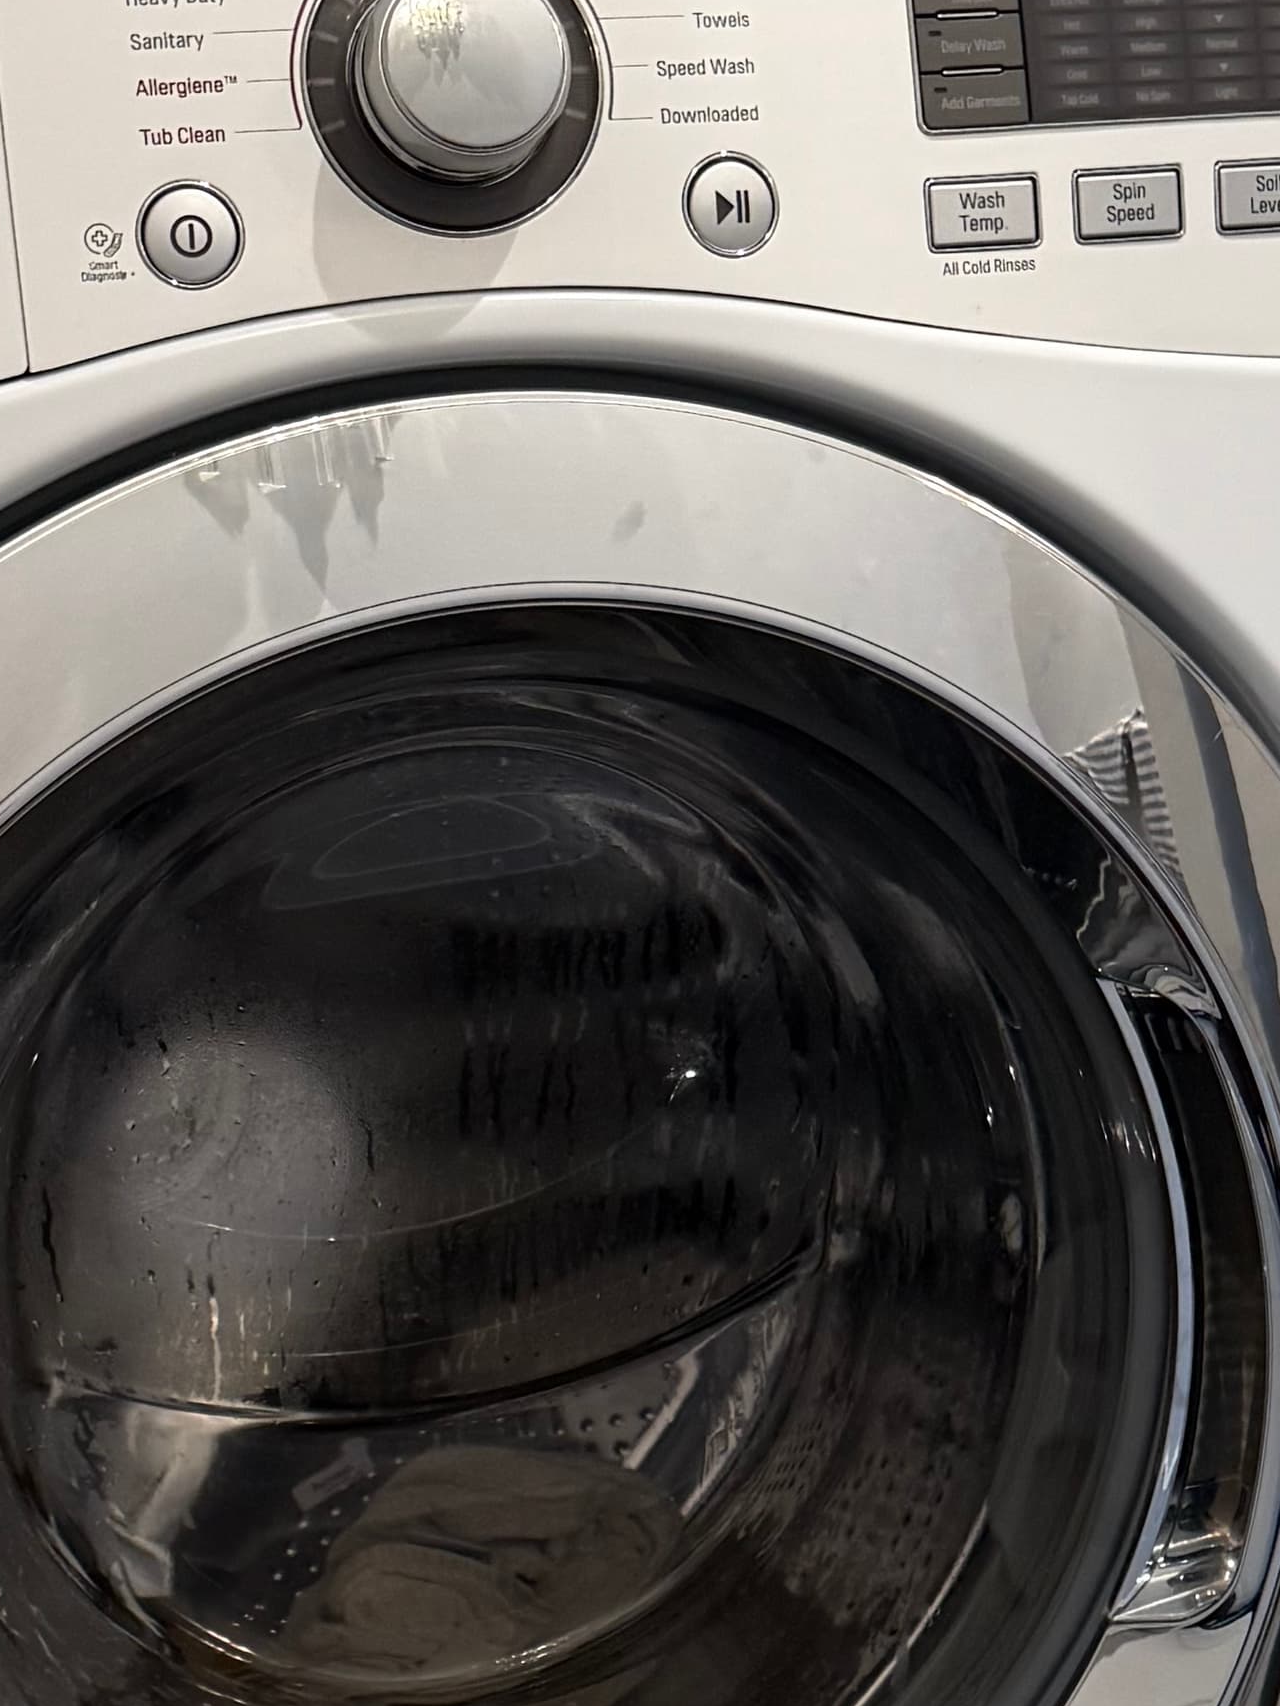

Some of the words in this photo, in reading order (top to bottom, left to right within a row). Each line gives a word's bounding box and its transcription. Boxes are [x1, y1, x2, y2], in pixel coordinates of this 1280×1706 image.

[692, 11, 750, 29] Towels
[130, 32, 204, 51] Sanitary
[974, 39, 1006, 52] Wash
[656, 59, 706, 80] Speed
[710, 58, 755, 75] Wash
[941, 98, 965, 110] Add
[661, 106, 759, 125] Downloaded
[139, 128, 173, 146] Tub
[177, 126, 225, 144] Clean
[959, 192, 1005, 210] Wash
[1112, 182, 1146, 202] Spin
[1106, 203, 1155, 224] Speed
[959, 214, 1008, 234] Temp.
[943, 262, 959, 276] All
[962, 260, 991, 275] Cold
[994, 258, 1036, 273] Rinses
